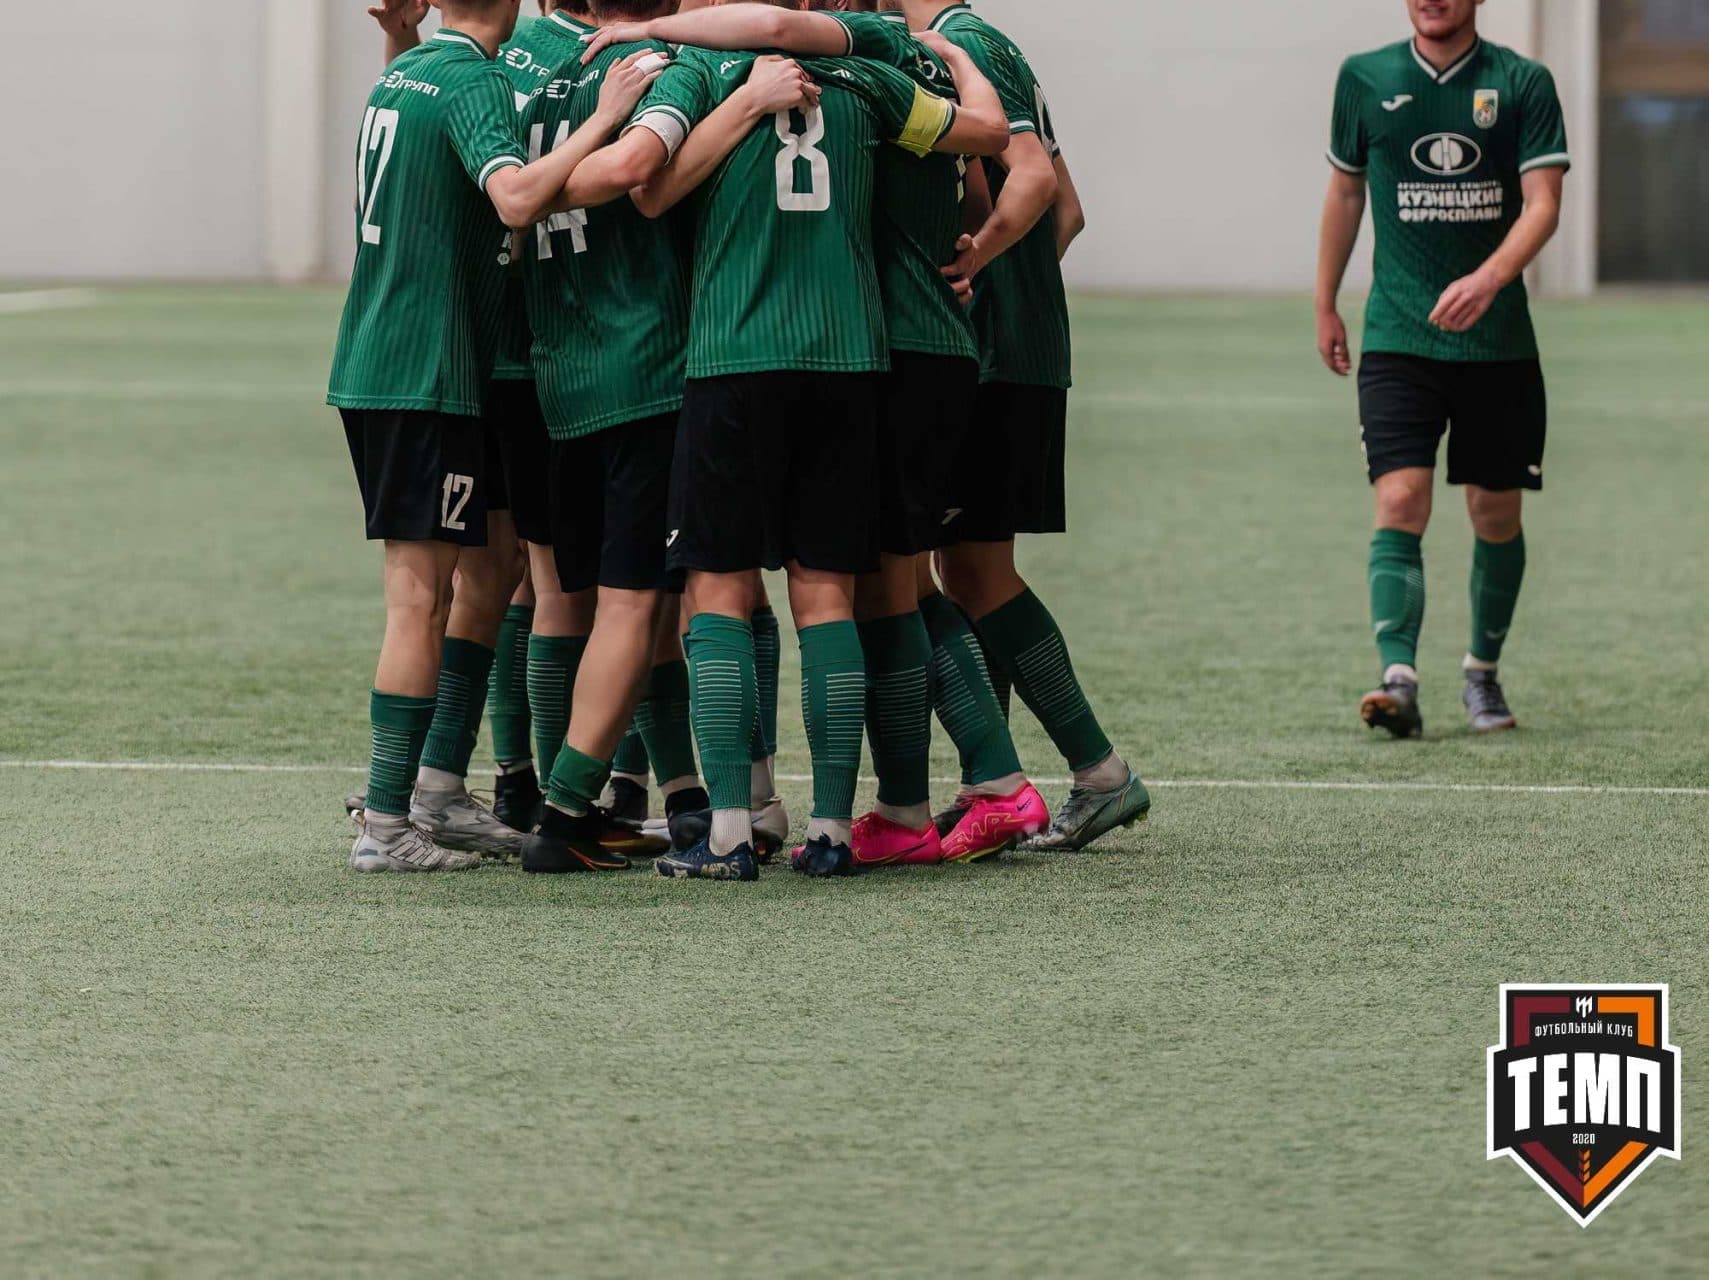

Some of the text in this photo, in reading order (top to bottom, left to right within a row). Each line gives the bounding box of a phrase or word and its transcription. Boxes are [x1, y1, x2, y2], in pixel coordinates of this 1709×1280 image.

[358, 105, 399, 245] 12
[775, 104, 830, 212] 8
[440, 472, 474, 531] 12
